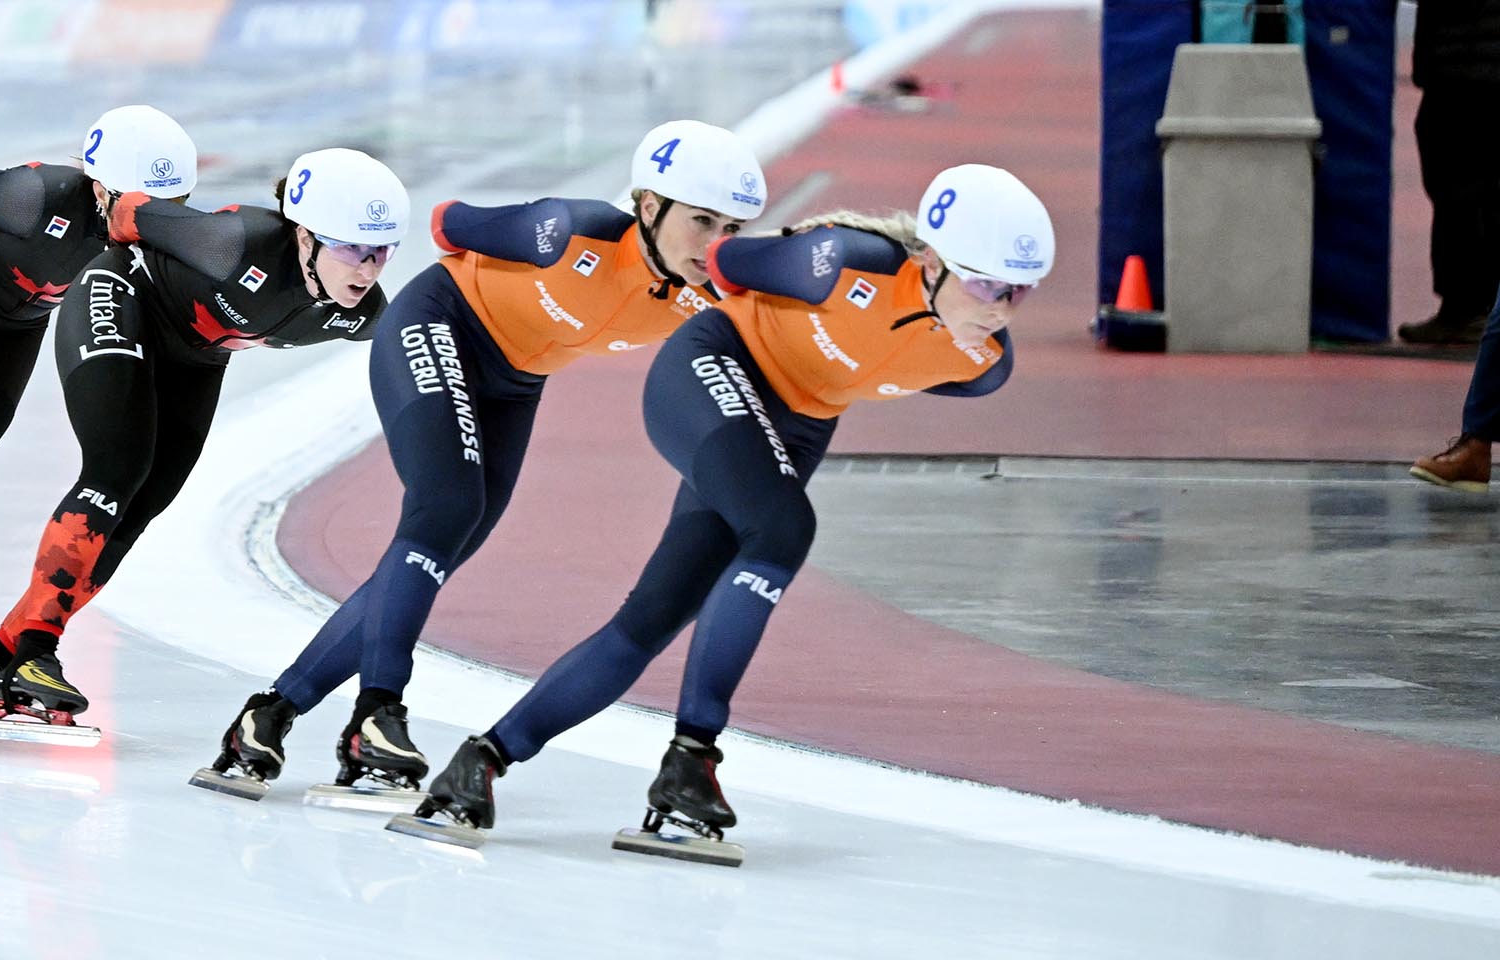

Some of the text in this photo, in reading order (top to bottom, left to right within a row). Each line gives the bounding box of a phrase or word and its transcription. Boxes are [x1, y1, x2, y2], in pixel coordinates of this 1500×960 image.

[84, 128, 103, 166] 2
[650, 138, 681, 174] 4
[152, 159, 173, 178] ISU
[289, 168, 312, 205] 3
[927, 188, 957, 230] 8
[215, 292, 249, 325] MAWER
[400, 323, 444, 395] LOTERIJ
[428, 322, 481, 465] NEDERLANDSE
[691, 355, 749, 417] LOTERIJ
[76, 487, 118, 516] FILA
[405, 550, 446, 586] FILA
[732, 570, 782, 604] FILA
